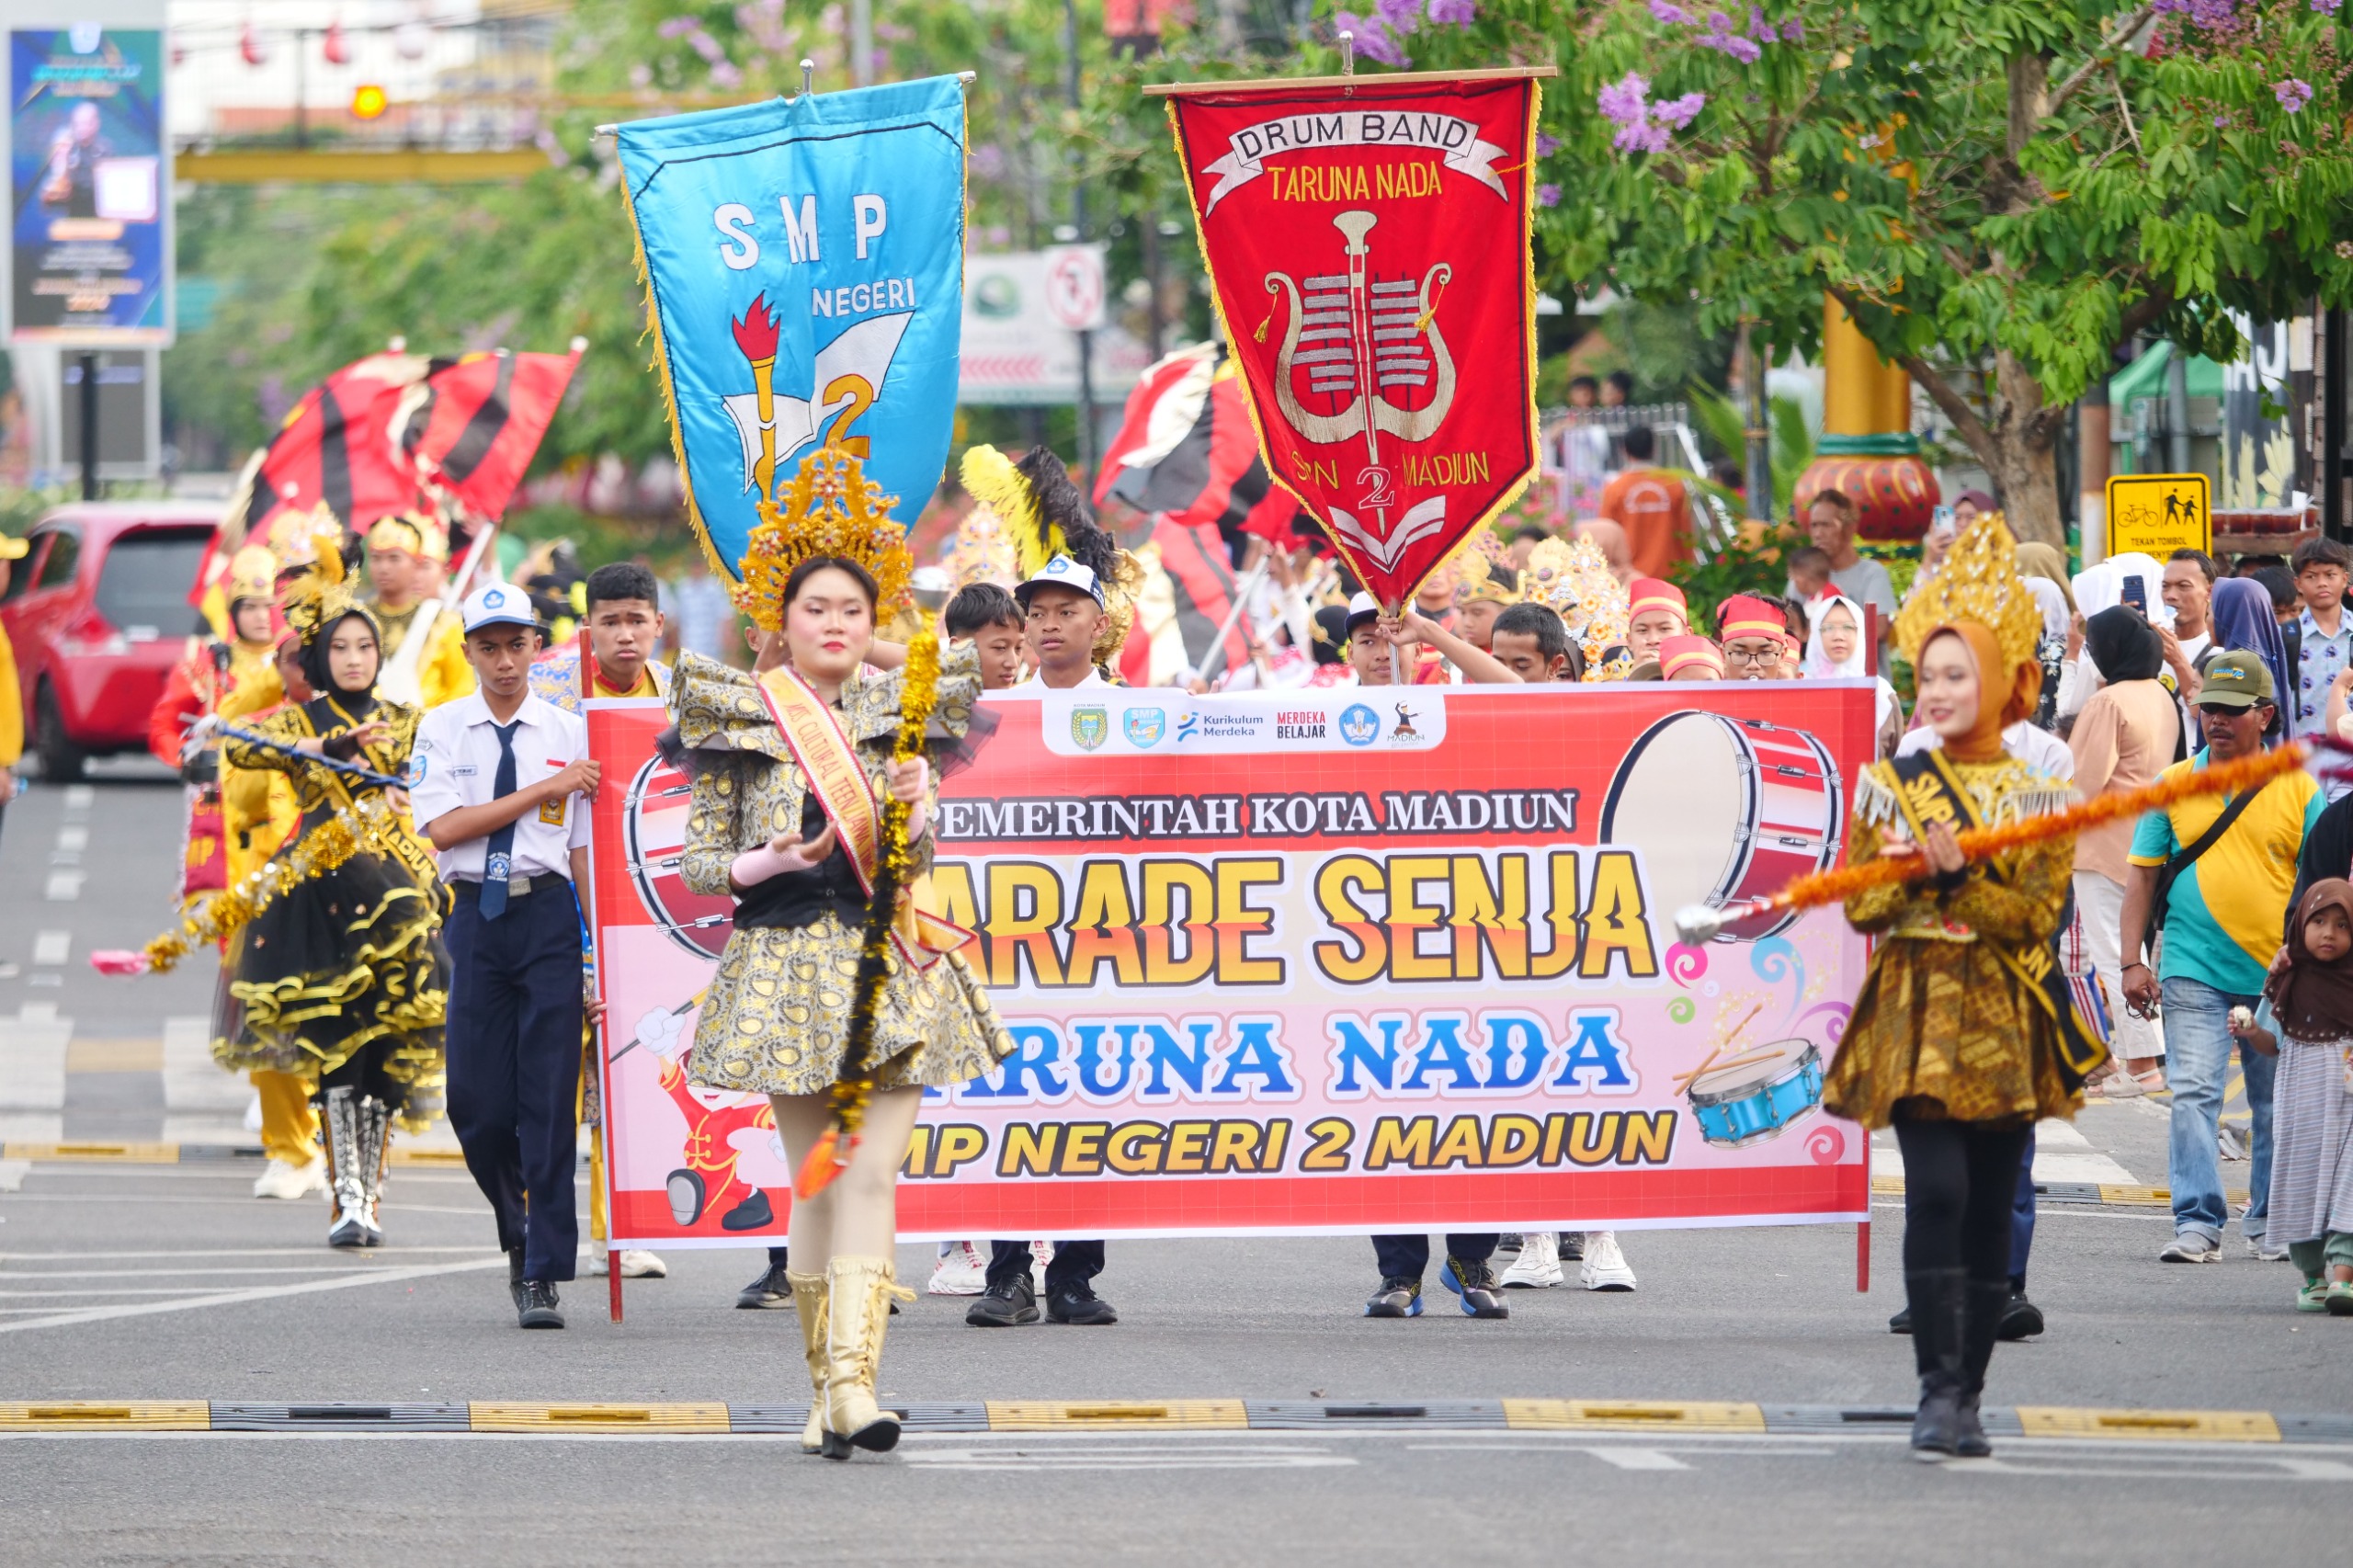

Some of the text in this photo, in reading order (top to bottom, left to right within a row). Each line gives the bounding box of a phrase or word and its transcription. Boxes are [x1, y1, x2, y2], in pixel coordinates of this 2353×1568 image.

[1236, 113, 1469, 160] DRUM BAND
[1267, 161, 1442, 203] TARUNA NADA
[812, 277, 916, 318] NEGERI
[822, 373, 874, 460] 2
[1356, 466, 1395, 510] 2
[1402, 450, 1491, 487] MADIUN
[2131, 536, 2188, 546] TEKAN TOMBOL
[1131, 709, 1158, 720] SMP
[1203, 714, 1264, 725] Kurikulum
[1203, 727, 1256, 737] Merdeka
[1277, 710, 1326, 725] MERDEKA
[1277, 724, 1326, 739] BELAJAR
[796, 722, 843, 780] CULTURAL
[1386, 733, 1426, 743] MADIUN
[1250, 795, 1378, 835] KOTA
[1384, 792, 1576, 832] MADIUN
[1313, 851, 1659, 985] SENJA
[1334, 1015, 1631, 1092] NADA
[998, 1120, 1290, 1174] NEGERI
[1302, 1119, 1354, 1169] 2
[1366, 1112, 1676, 1168] MADIUN
